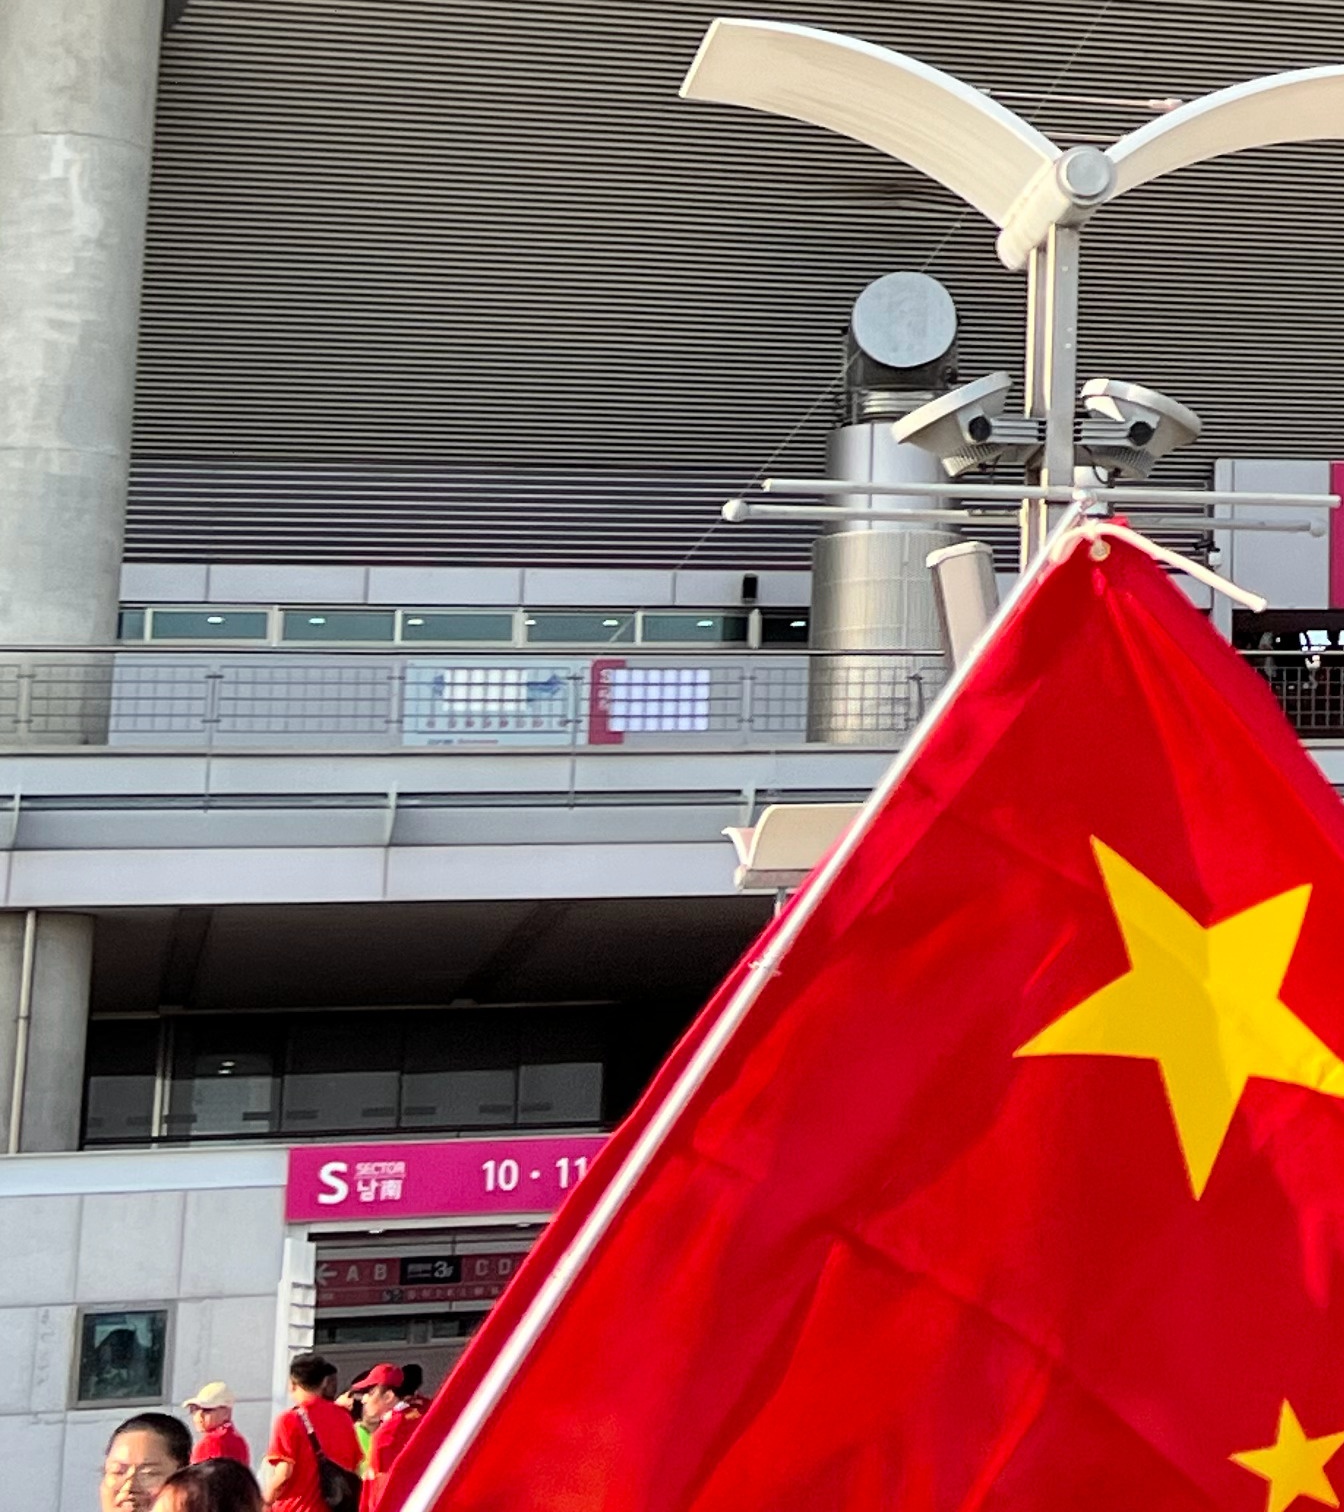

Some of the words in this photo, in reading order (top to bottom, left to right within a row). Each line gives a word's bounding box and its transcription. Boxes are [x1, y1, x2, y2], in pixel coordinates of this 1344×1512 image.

[317, 1161, 349, 1205] S
[481, 1159, 520, 1192] 10
[346, 1265, 360, 1282] A
[374, 1263, 388, 1281] B
